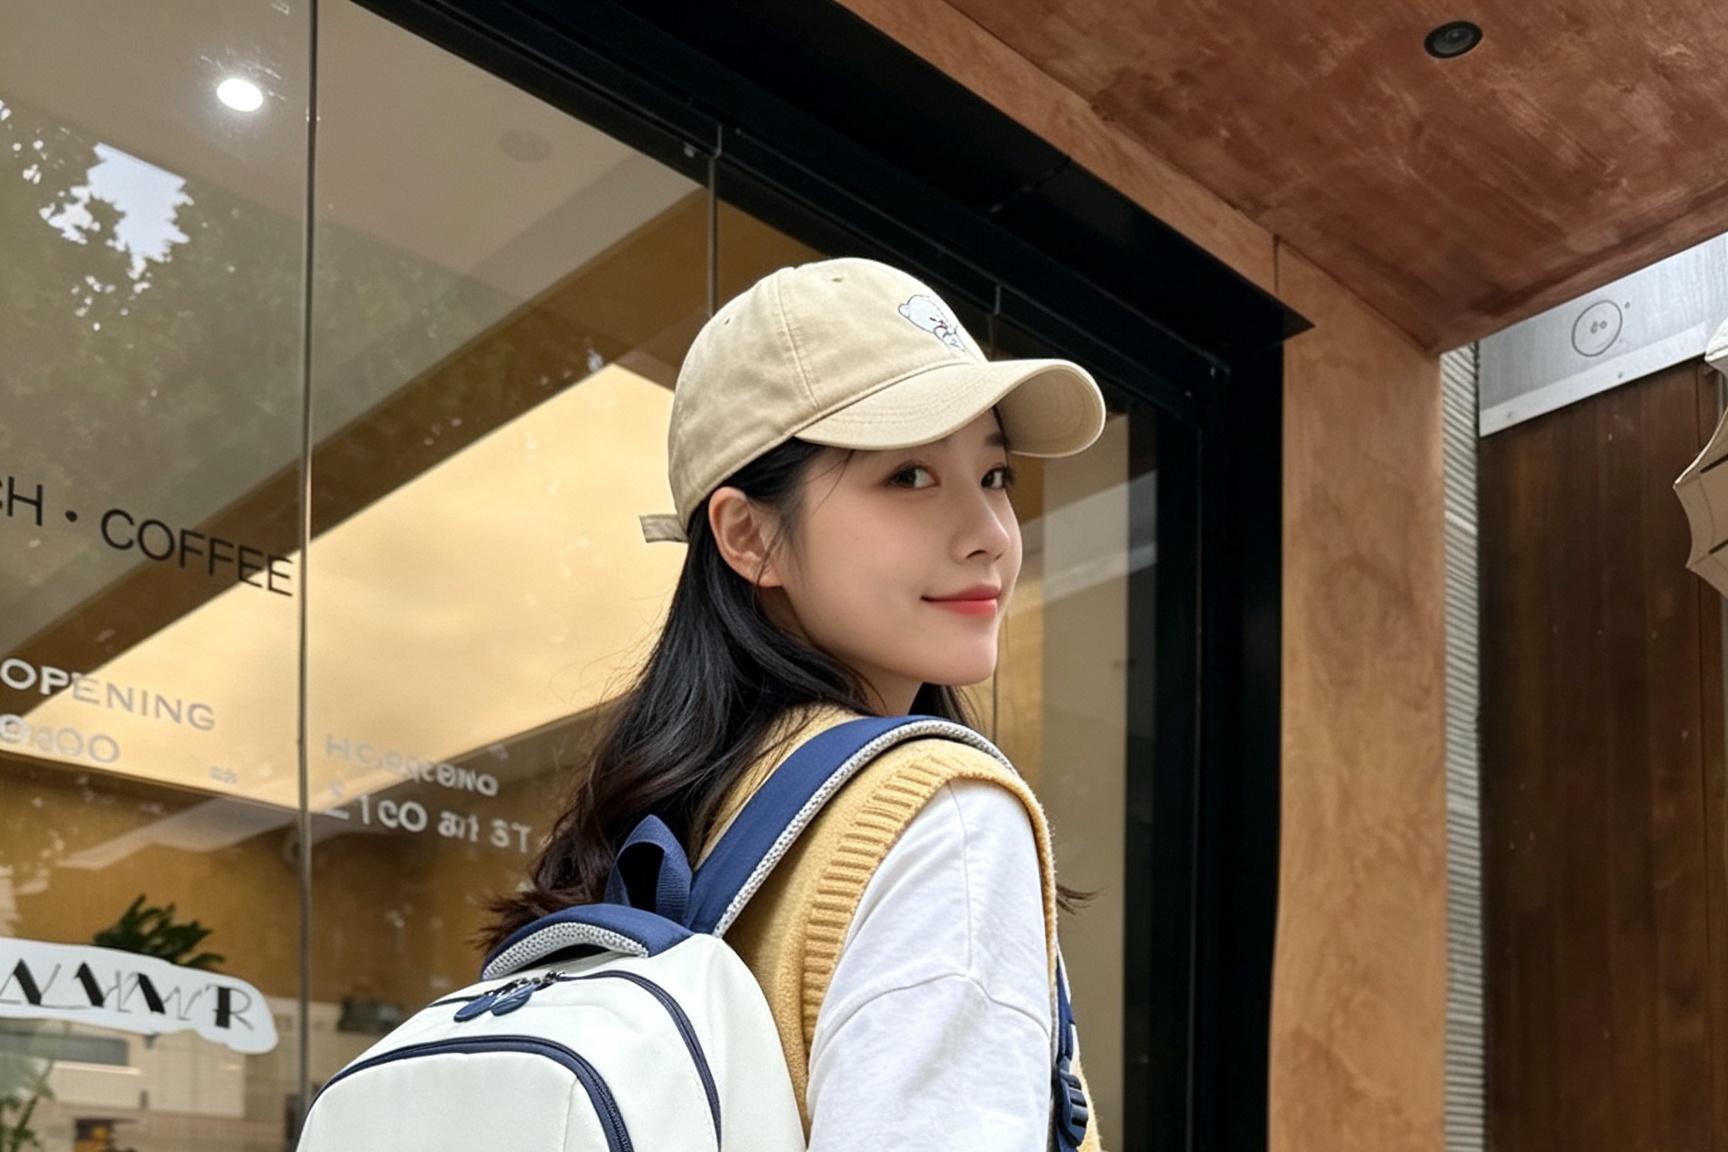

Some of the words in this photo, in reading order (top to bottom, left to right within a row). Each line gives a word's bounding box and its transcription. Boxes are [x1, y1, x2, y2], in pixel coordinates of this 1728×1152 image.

[0, 476, 43, 526] H
[101, 508, 293, 597] COFFEE
[0, 658, 215, 731] OPENING
